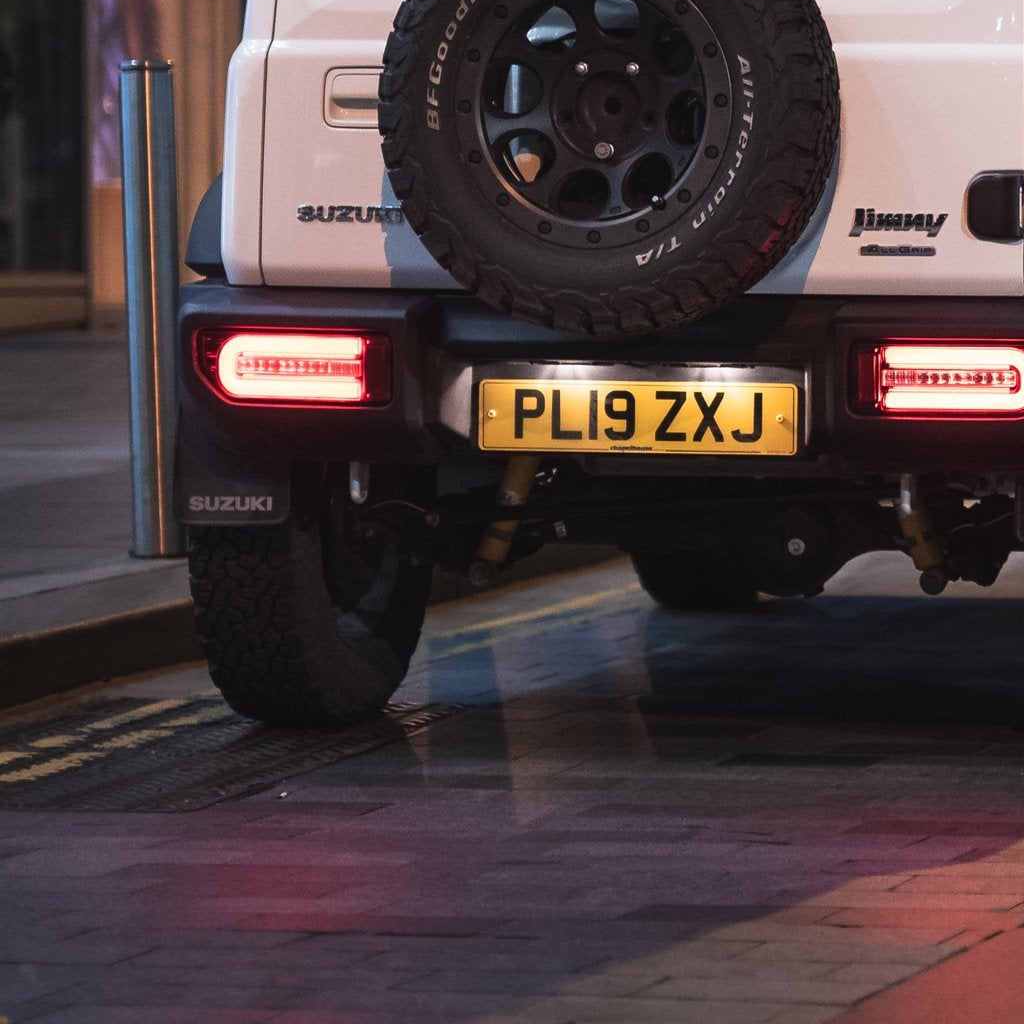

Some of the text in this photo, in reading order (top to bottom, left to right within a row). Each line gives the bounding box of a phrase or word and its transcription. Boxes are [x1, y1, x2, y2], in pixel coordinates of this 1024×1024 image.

[635, 54, 754, 267] All-Terrain T/A
[848, 208, 949, 237] Jimny
[514, 388, 763, 443] PL19 ZXJ
[189, 496, 273, 511] SUZUKI
